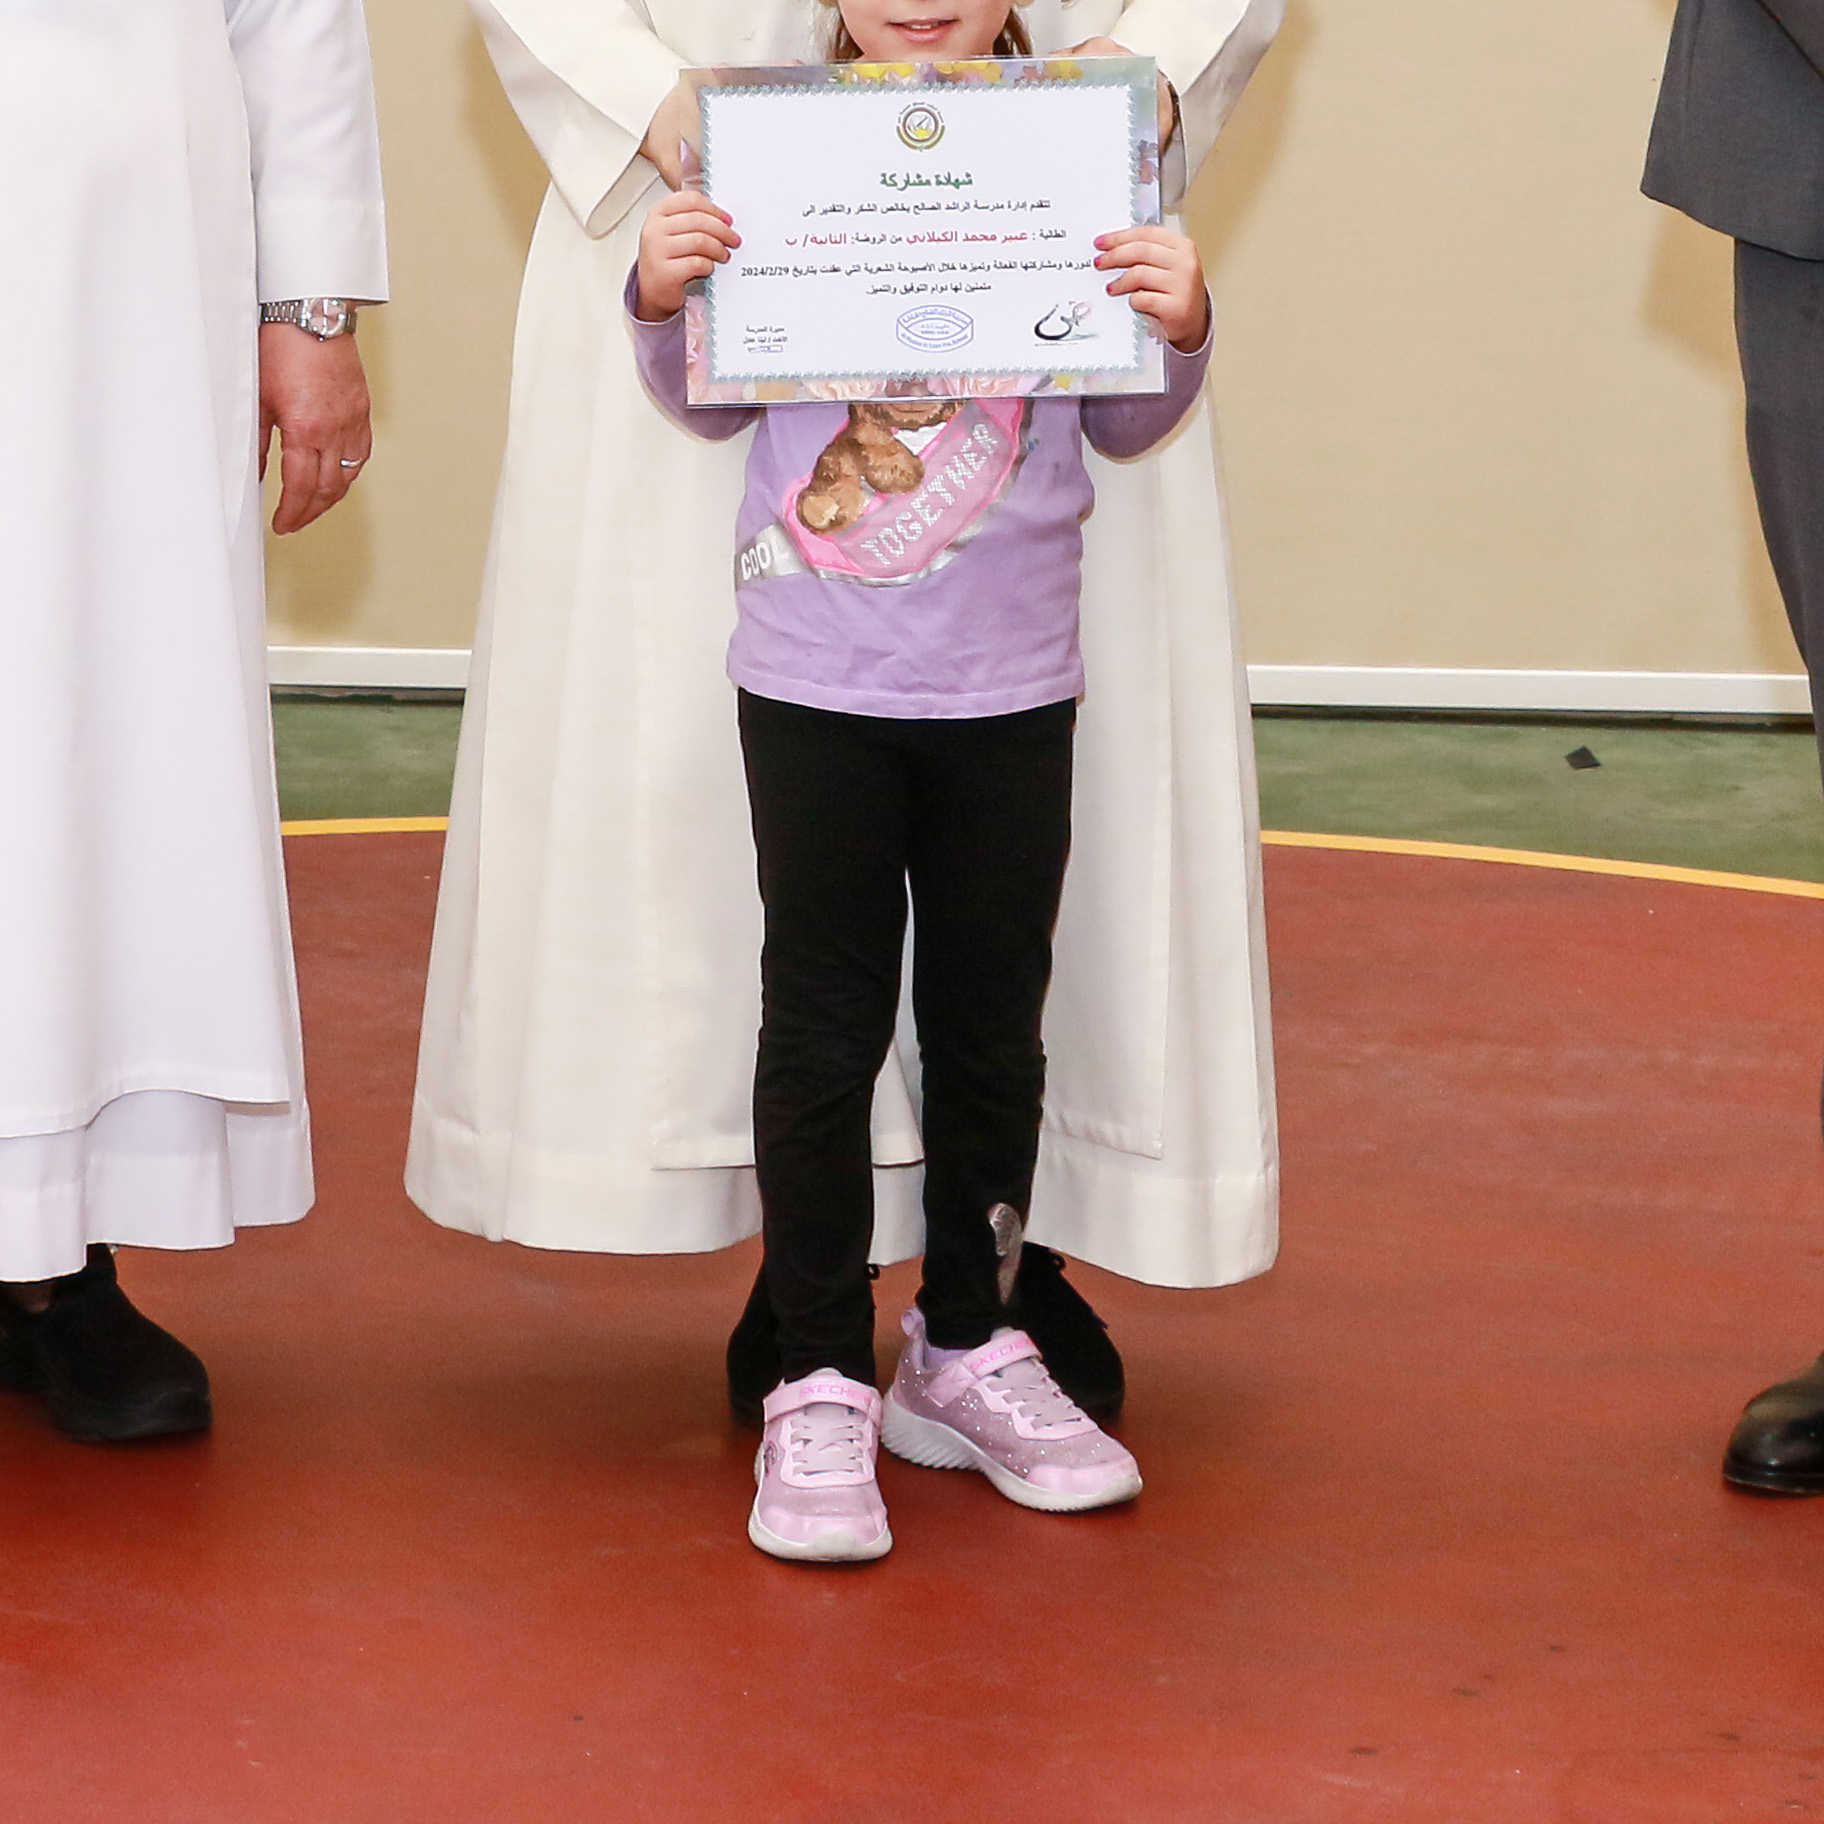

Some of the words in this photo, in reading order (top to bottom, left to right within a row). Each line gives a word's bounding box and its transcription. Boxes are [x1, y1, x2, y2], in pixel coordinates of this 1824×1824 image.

[879, 172, 932, 191] مشاركة
[934, 171, 974, 190] شهادة
[818, 203, 852, 216] والتقدير
[855, 202, 878, 215] الشكر
[880, 202, 911, 214] بخالص
[913, 201, 942, 215] الصالح
[944, 201, 971, 213] الراشد
[973, 199, 1004, 212] مدرسة
[1007, 200, 1027, 211] إدارة
[1030, 199, 1051, 212] تتقدم
[889, 235, 903, 245] من
[962, 231, 998, 243] محمد
[1001, 231, 1029, 244] عبير
[1038, 228, 1067, 240] الطالبة
[844, 264, 862, 276] التي
[863, 262, 895, 275] الشعرية
[938, 261, 957, 273] خلال
[992, 259, 1018, 270] الفعالة
[1019, 259, 1063, 272] ومشاركتها
[1064, 258, 1092, 271] لدورها
[740, 266, 790, 277] 2024/2/29
[792, 265, 818, 278] بتاريخ
[899, 282, 929, 295] التوفيق
[930, 283, 948, 294] دوام
[950, 282, 963, 293] لها
[860, 423, 998, 566] TOGETHER
[740, 539, 790, 581] COOL
